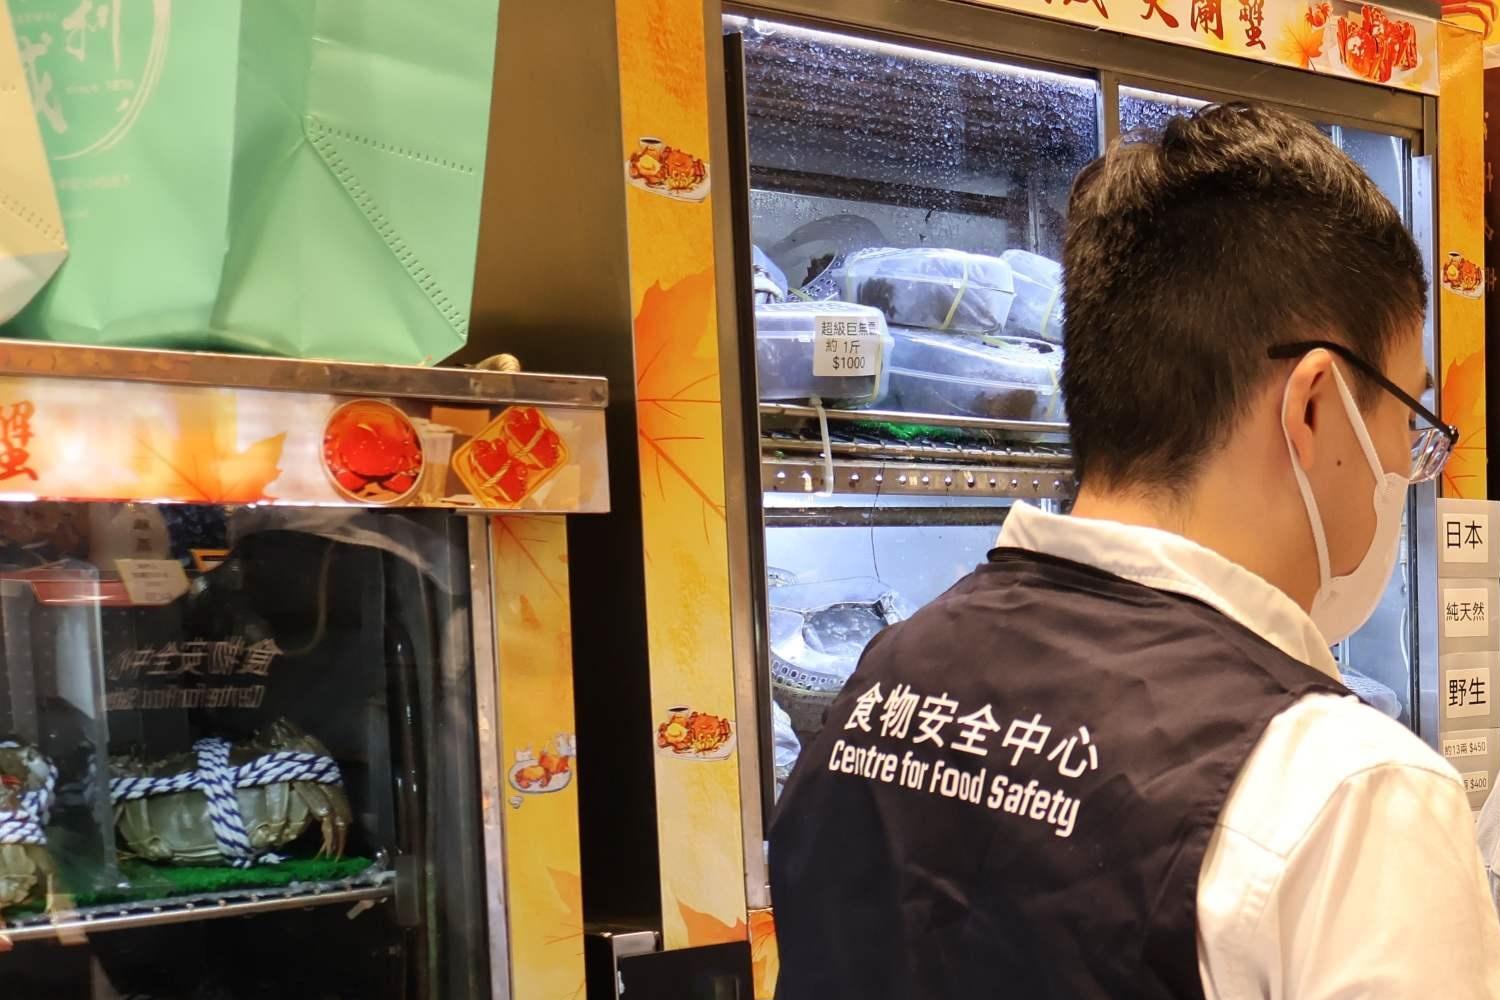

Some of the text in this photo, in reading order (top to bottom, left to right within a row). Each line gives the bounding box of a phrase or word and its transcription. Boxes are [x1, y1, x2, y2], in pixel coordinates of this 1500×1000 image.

[832, 356, 866, 370] $1000
[1446, 520, 1483, 550] 日本
[1446, 602, 1485, 622] 純天然
[1448, 677, 1487, 707] 野生
[844, 681, 1099, 779] 食物安全中心
[1469, 741, 1486, 753] $450
[828, 739, 1081, 838] Centre for Food Safety
[1470, 778, 1487, 789] $400
